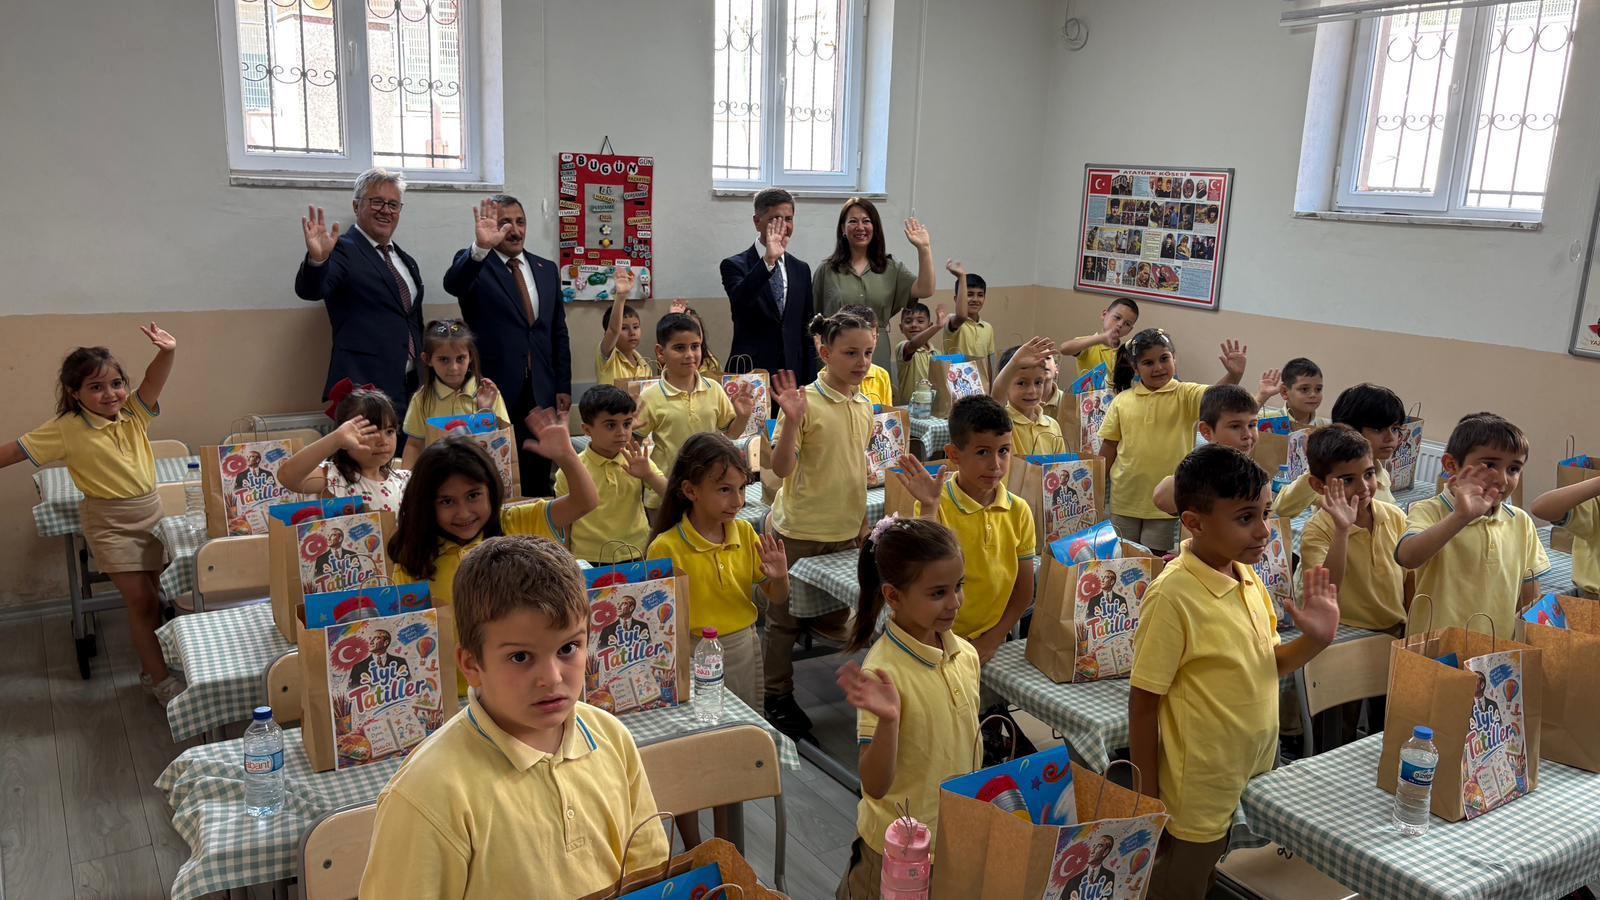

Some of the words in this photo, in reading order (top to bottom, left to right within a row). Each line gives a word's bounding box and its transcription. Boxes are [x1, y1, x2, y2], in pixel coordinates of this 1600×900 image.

[577, 155, 637, 174] BUGÜN
[248, 472, 267, 488] İyi
[235, 485, 285, 505] Tatiller
[1052, 502, 1087, 521] Tatiller
[330, 554, 351, 574] İyi
[315, 569, 373, 592] Tatiller
[1101, 598, 1120, 618] İyi
[617, 625, 641, 647] İyi
[1087, 616, 1138, 640] Tatiller
[598, 642, 662, 671] Tatiller
[369, 661, 397, 685] İyi
[348, 680, 425, 713] Tatiller
[1474, 705, 1494, 731] İyi
[1466, 723, 1511, 760] Tatiller
[1081, 875, 1107, 900] İyi
